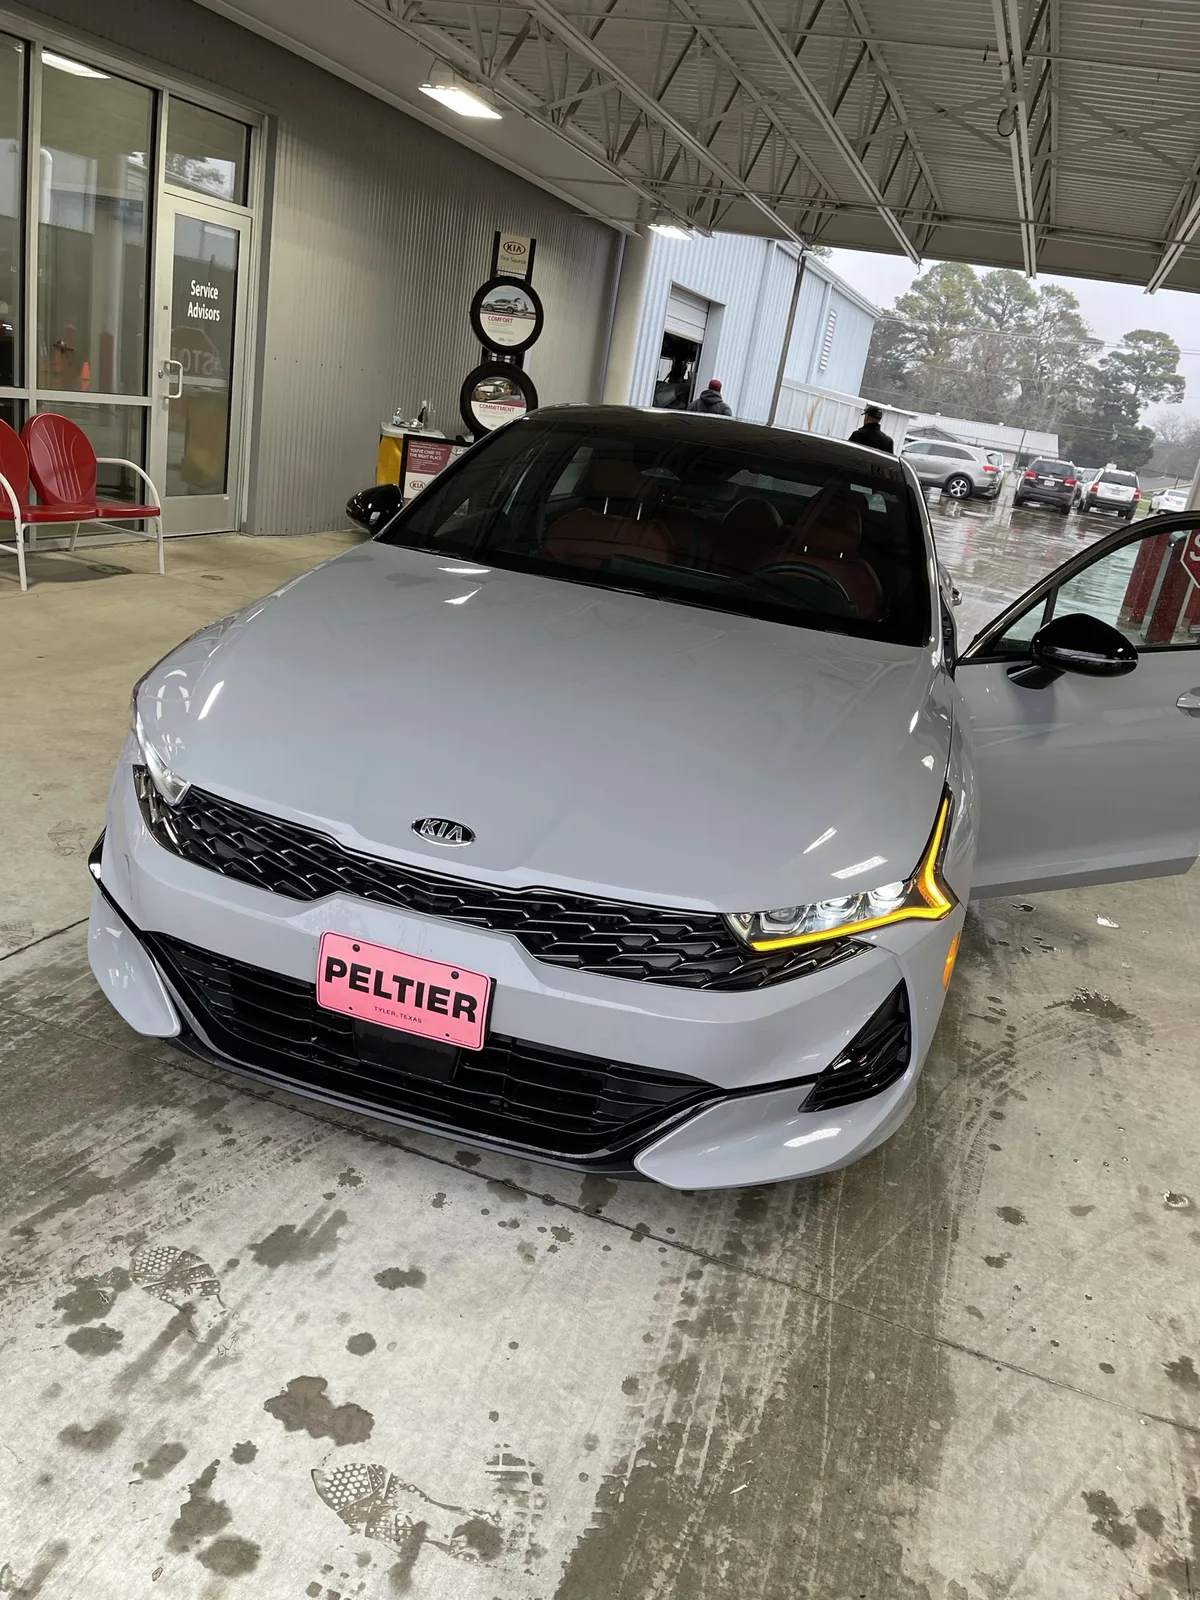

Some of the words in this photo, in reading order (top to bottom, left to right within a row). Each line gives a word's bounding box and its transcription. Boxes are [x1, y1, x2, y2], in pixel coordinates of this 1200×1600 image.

[507, 244, 521, 252] KIA
[510, 257, 526, 265] Source
[190, 280, 218, 299] Service
[187, 302, 220, 321] Advisors
[479, 404, 514, 412] COMMITMENT
[420, 819, 462, 843] KIA
[324, 955, 479, 1024] PELTIER
[374, 1006, 398, 1018] TYLER,
[400, 1013, 422, 1023] TEXAS
